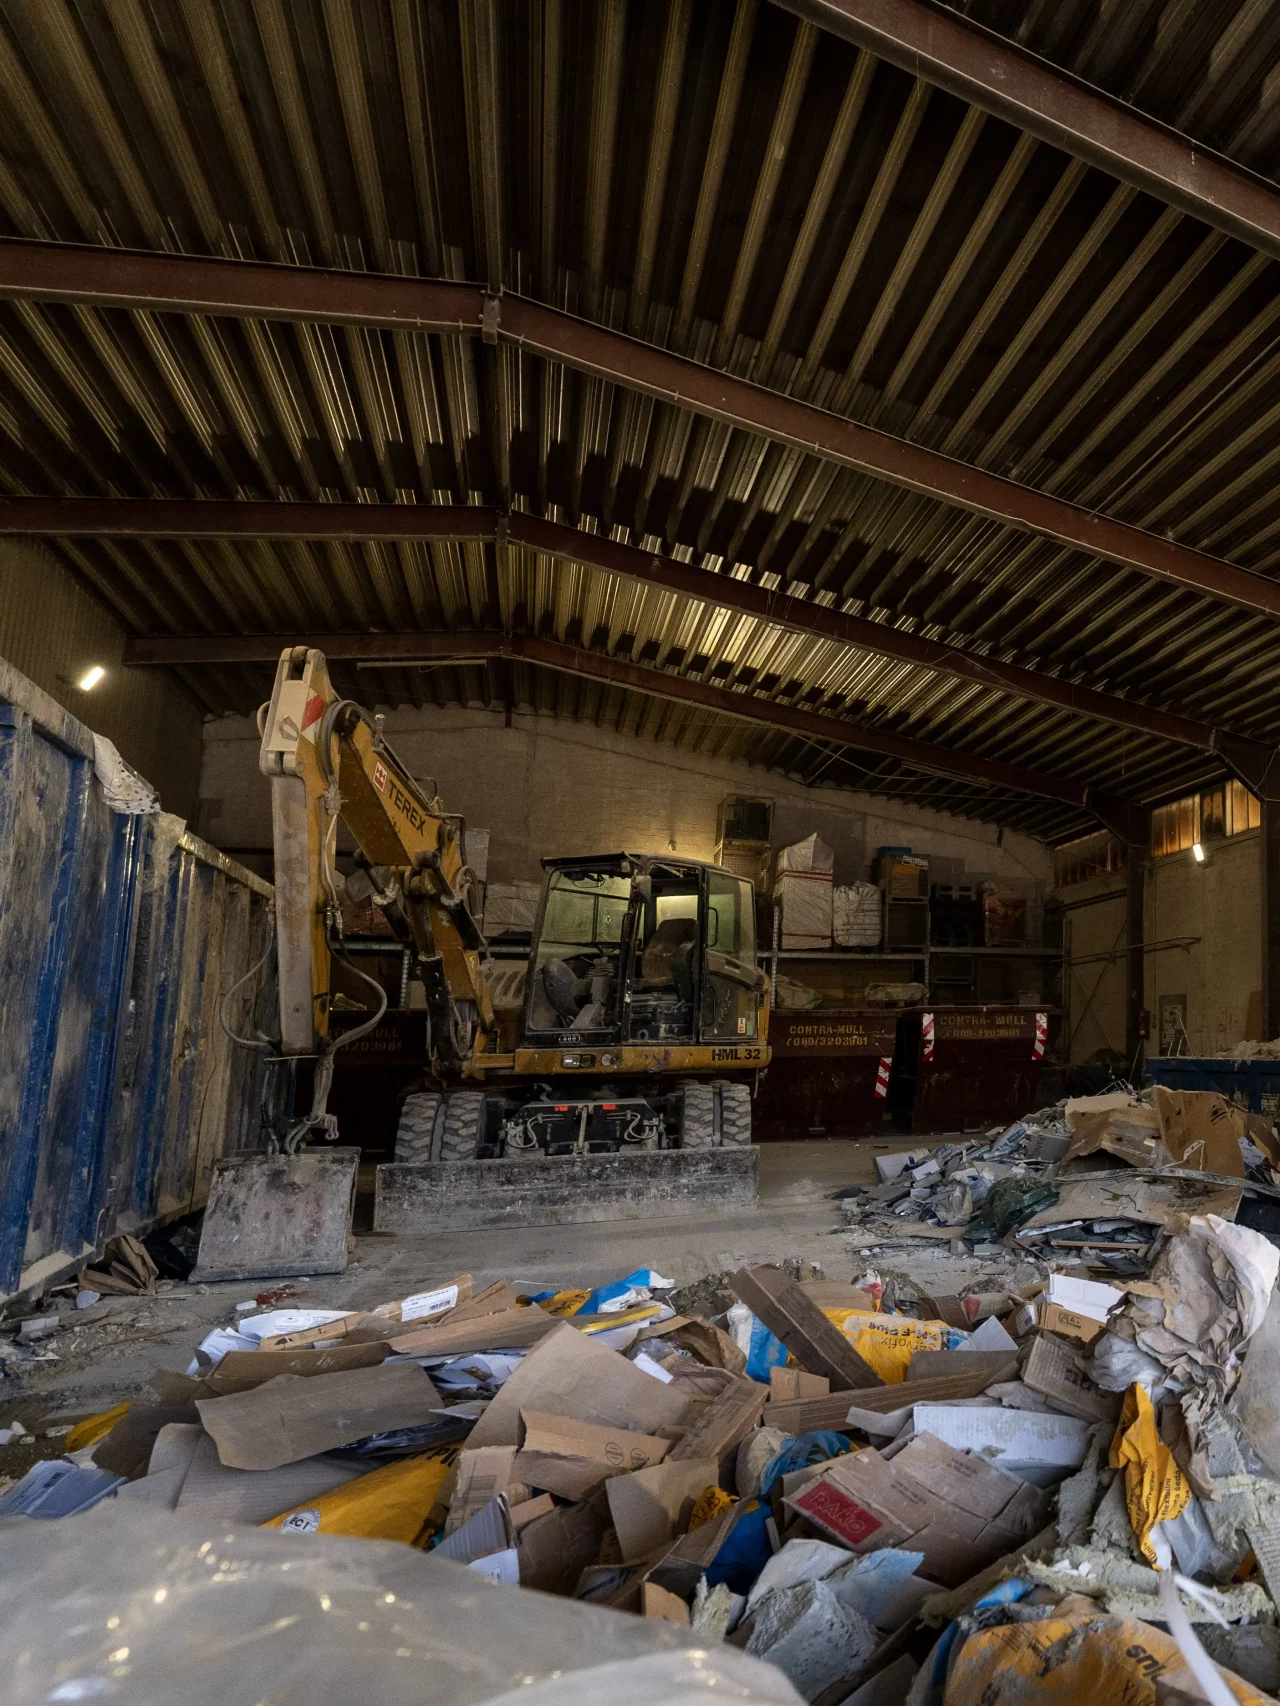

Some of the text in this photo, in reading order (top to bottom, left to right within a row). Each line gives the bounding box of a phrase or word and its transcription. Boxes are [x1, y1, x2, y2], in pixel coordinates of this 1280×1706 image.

[389, 780, 426, 837] TEREX
[712, 1048, 761, 1061] HML 32
[289, 1516, 304, 1527] EC
[808, 1491, 865, 1534] RAKO
